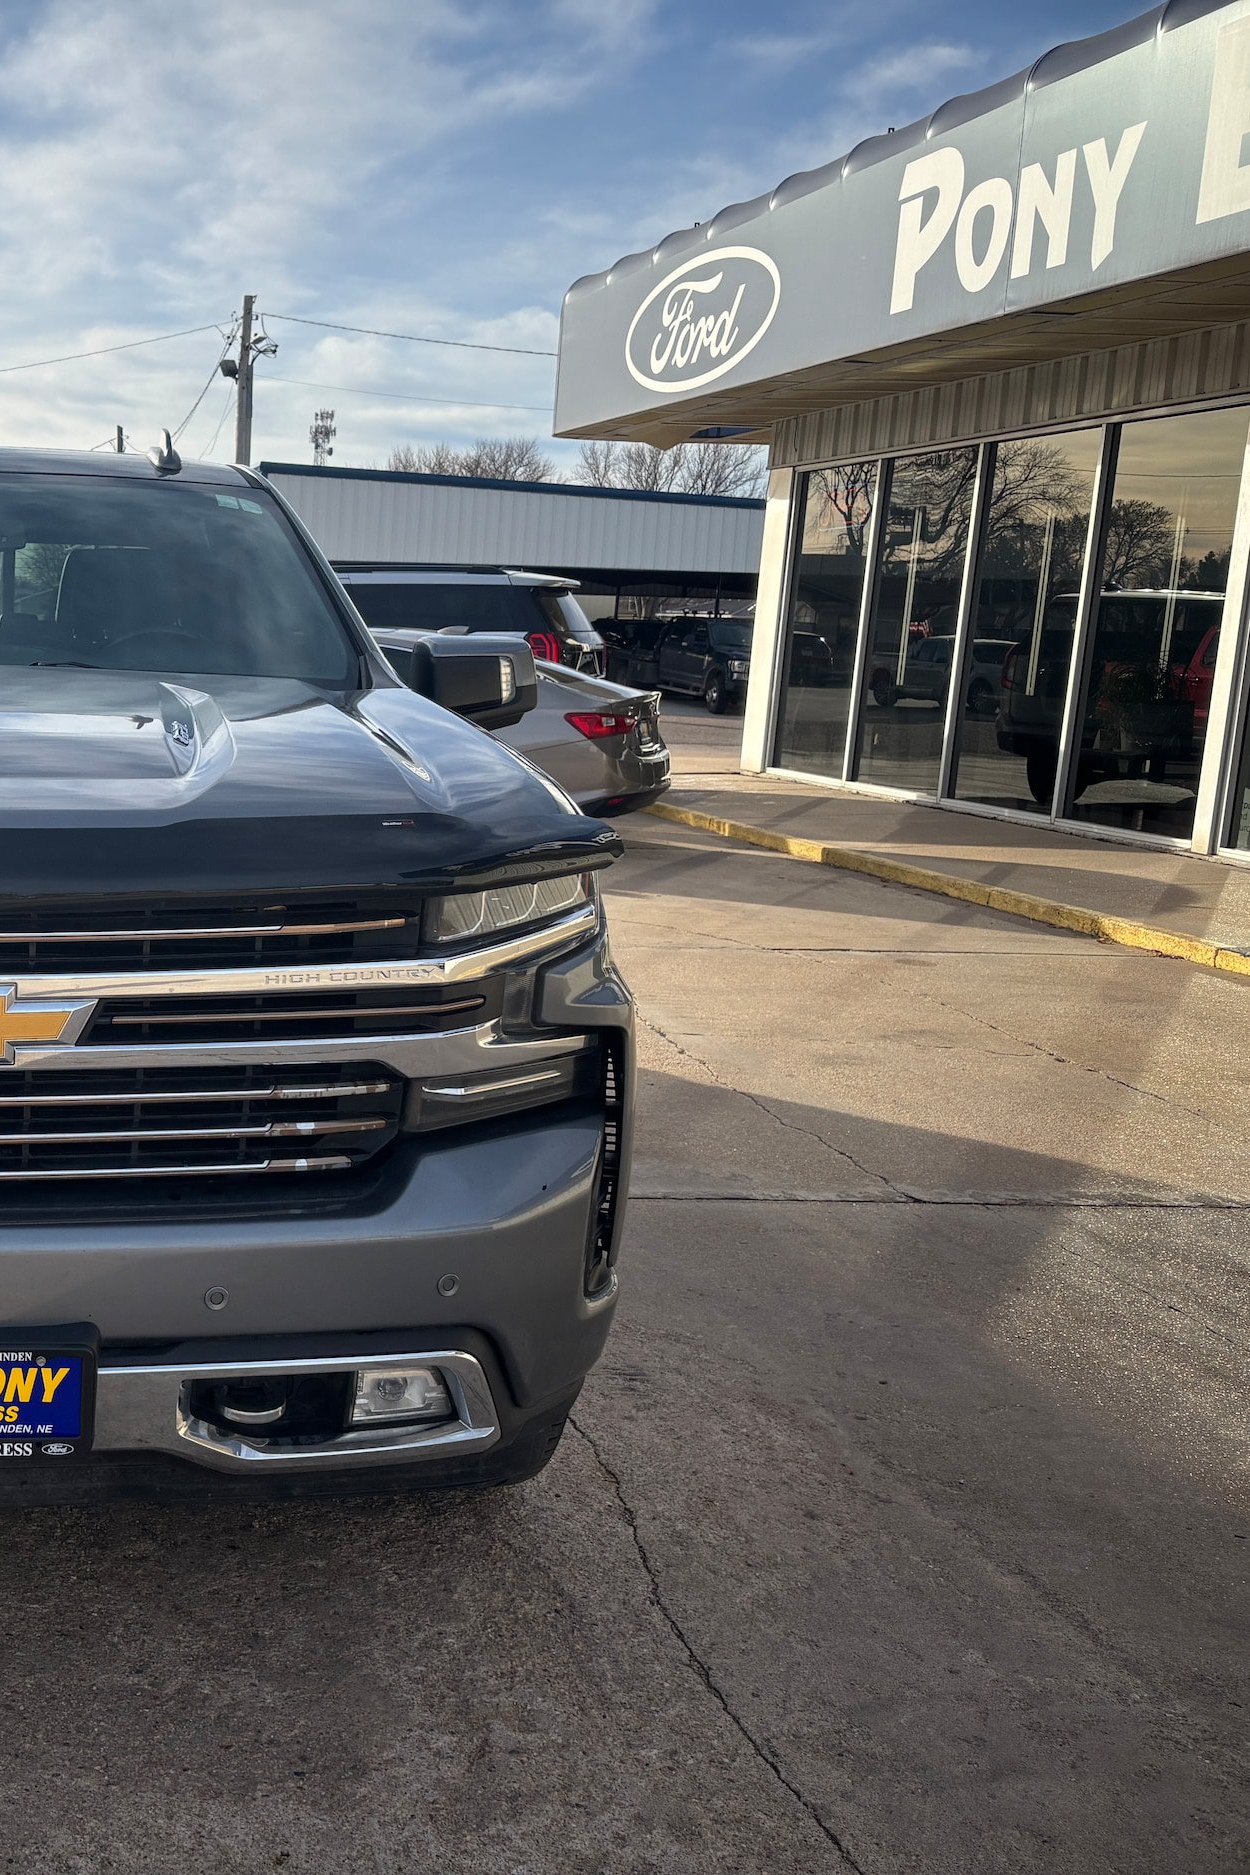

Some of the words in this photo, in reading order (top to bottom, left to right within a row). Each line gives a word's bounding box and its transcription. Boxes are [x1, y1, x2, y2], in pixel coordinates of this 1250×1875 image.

[889, 120, 1148, 316] PONY
[650, 271, 745, 375] Ford
[265, 974, 321, 985] HIGH
[330, 968, 436, 982] COUNTRY
[37, 1425, 54, 1434] NE
[47, 1444, 69, 1455] Ford
